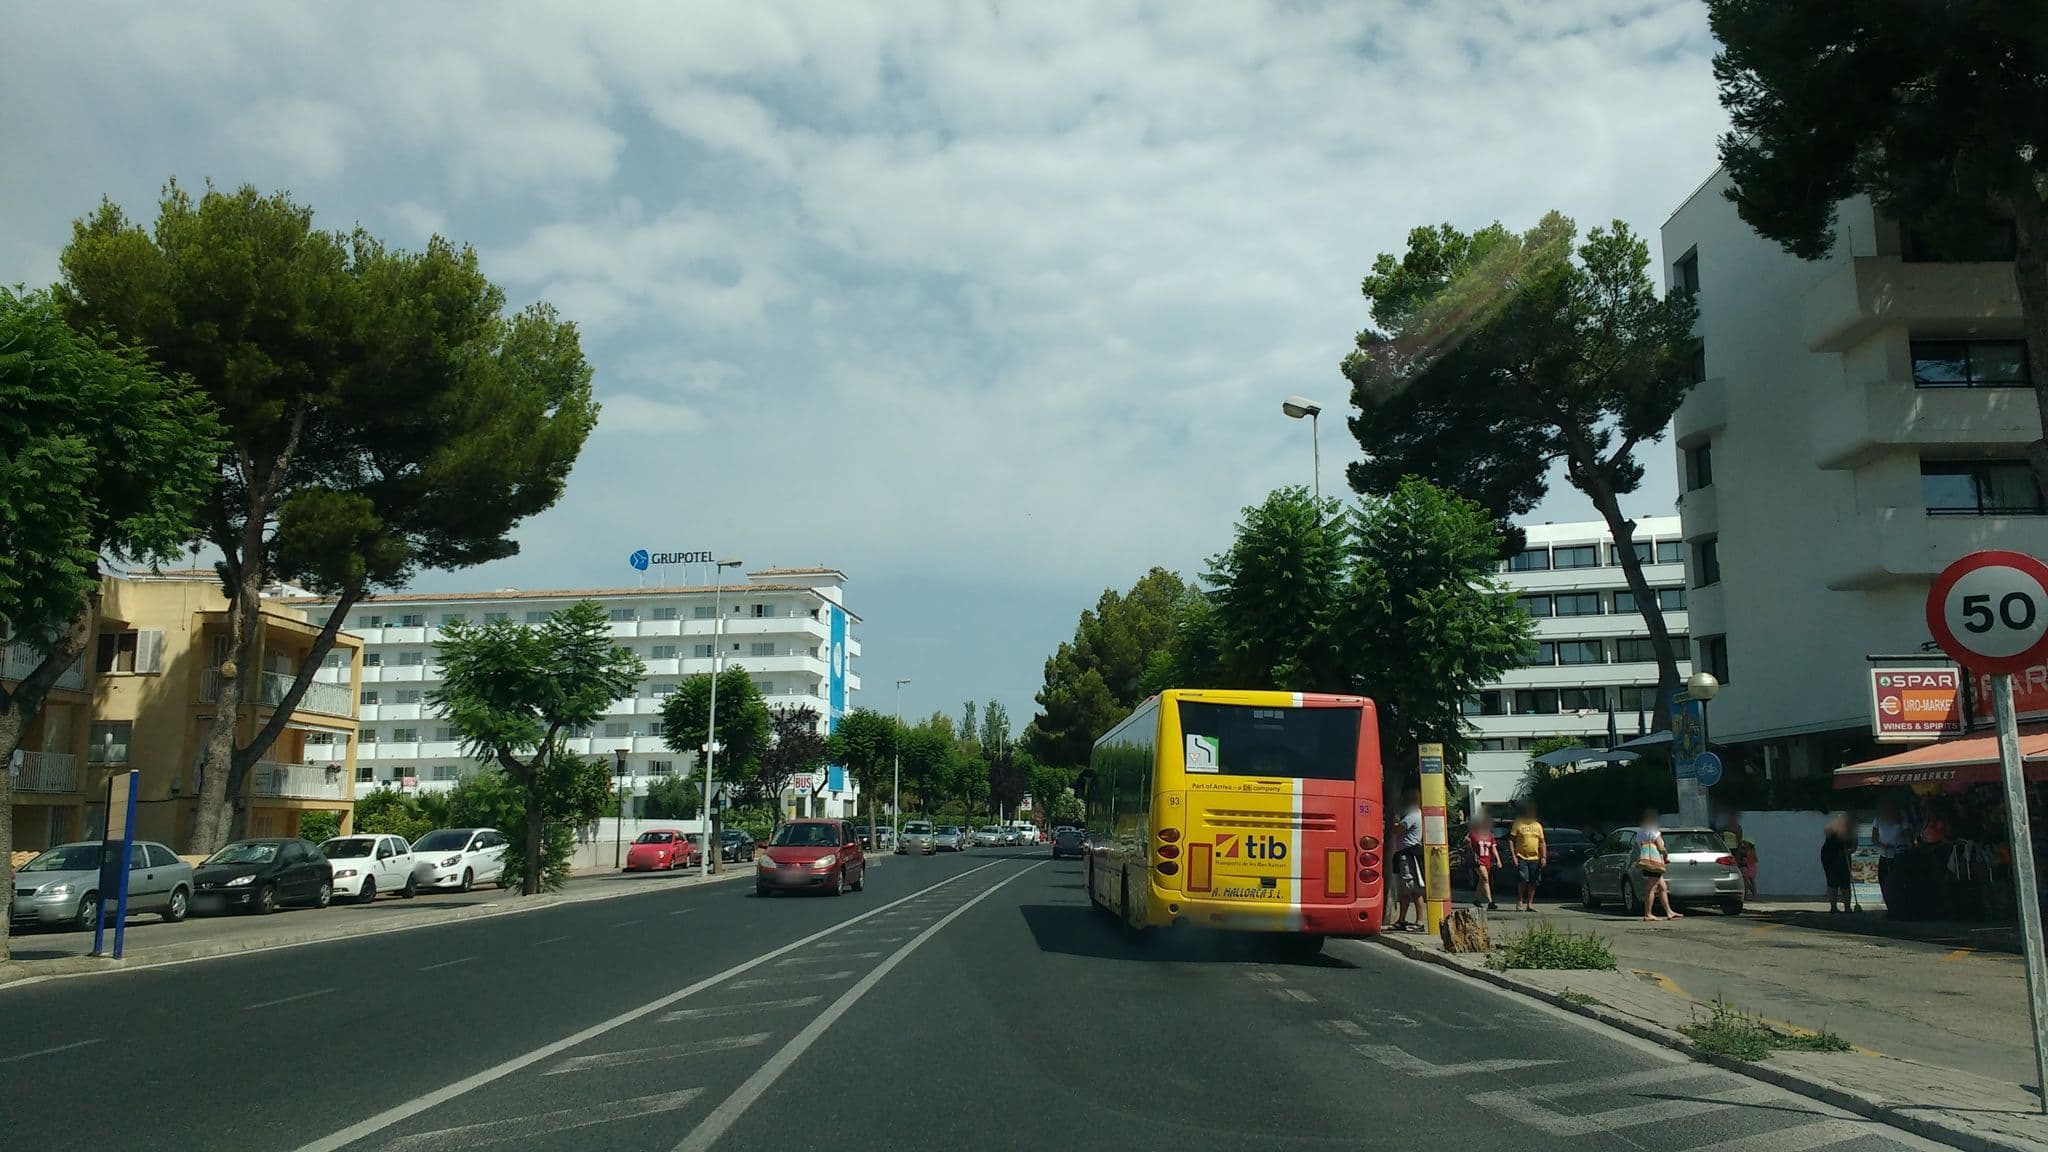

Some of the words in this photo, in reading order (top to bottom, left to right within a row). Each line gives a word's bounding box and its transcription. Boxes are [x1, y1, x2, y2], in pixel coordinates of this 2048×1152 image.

[651, 551, 715, 565] GRUPOTEL
[1963, 591, 2036, 634] 50
[1892, 674, 1953, 688] SPAR
[1883, 722, 1913, 731] WINES
[1914, 722, 1921, 730] &
[1923, 722, 1958, 730] SPIRITS
[794, 775, 812, 789] BUS
[1878, 770, 1957, 784] SUPERMARKET
[1169, 796, 1180, 806] 93
[1359, 804, 1370, 814] 93
[1245, 835, 1287, 860] tib
[1223, 888, 1267, 899] MALLORCA
